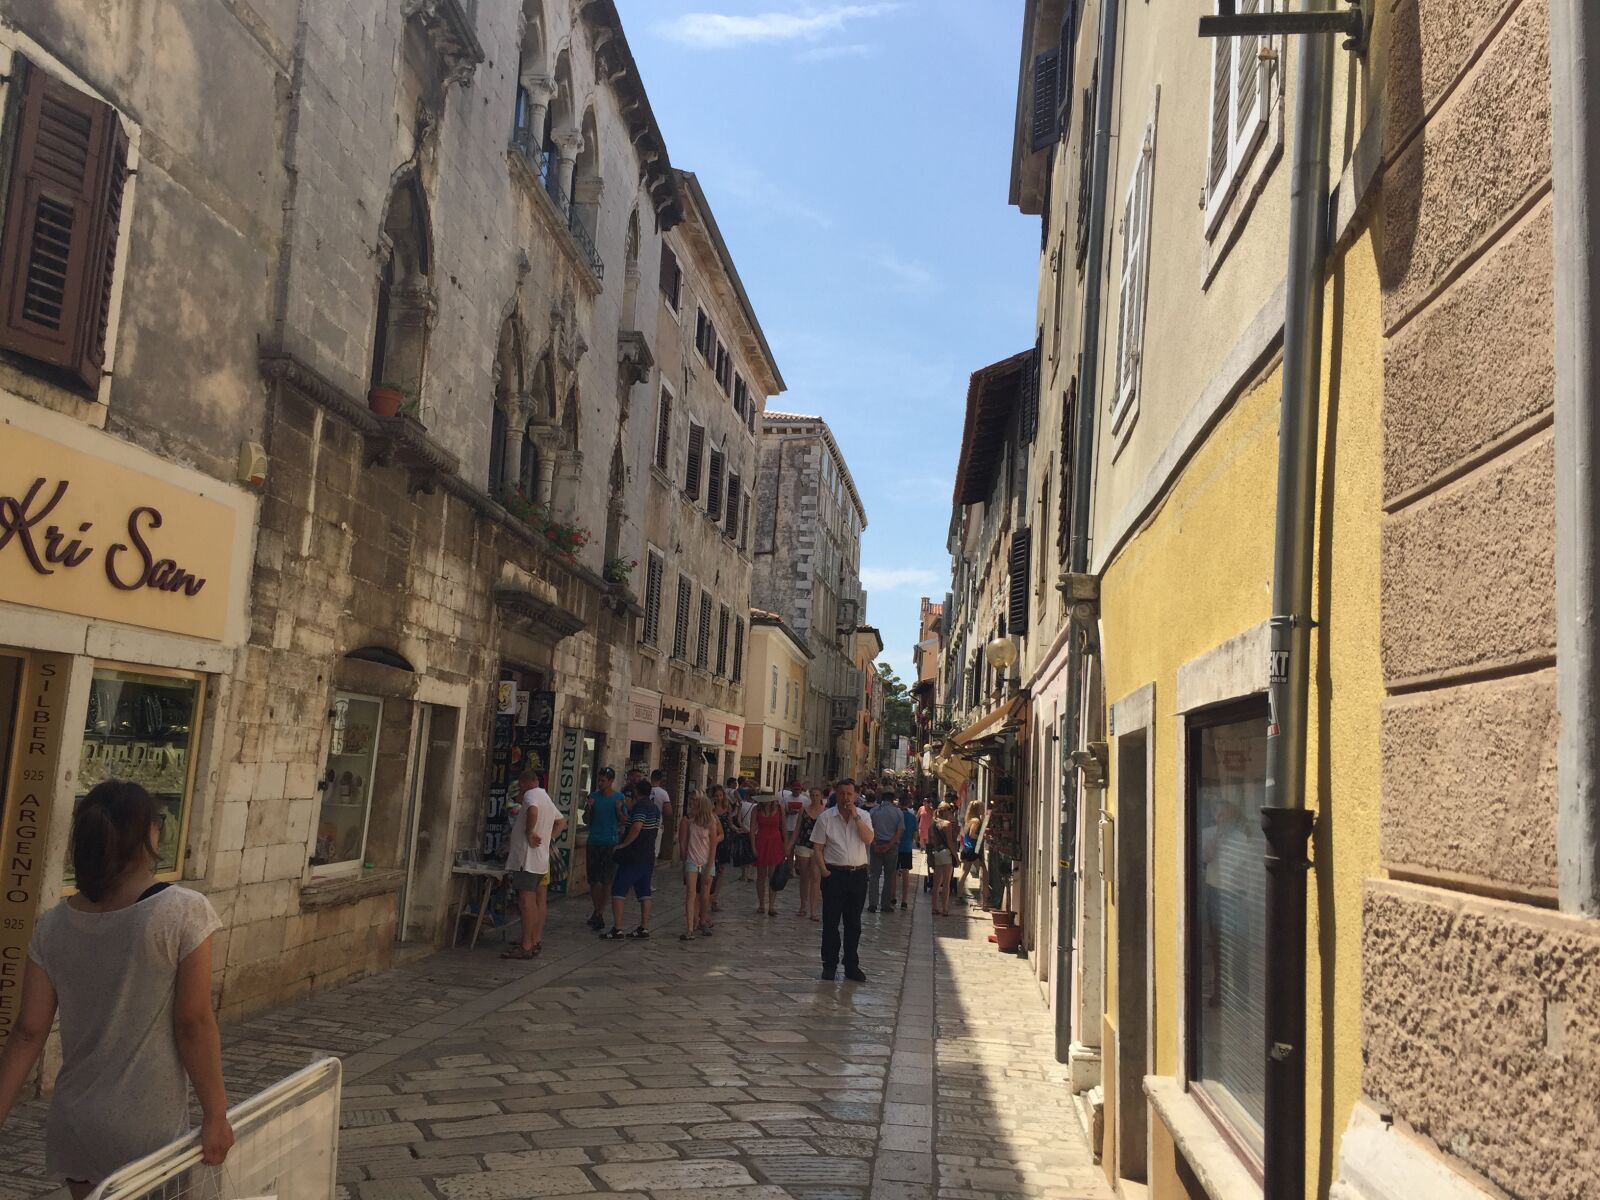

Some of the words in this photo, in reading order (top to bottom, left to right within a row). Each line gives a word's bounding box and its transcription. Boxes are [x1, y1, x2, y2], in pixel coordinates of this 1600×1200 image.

[0, 477, 94, 575] Kri
[105, 506, 206, 596] San
[28, 663, 56, 755] SILBER
[23, 769, 44, 780] 925
[6, 793, 40, 903] ARGENTO
[3, 918, 24, 929] 925
